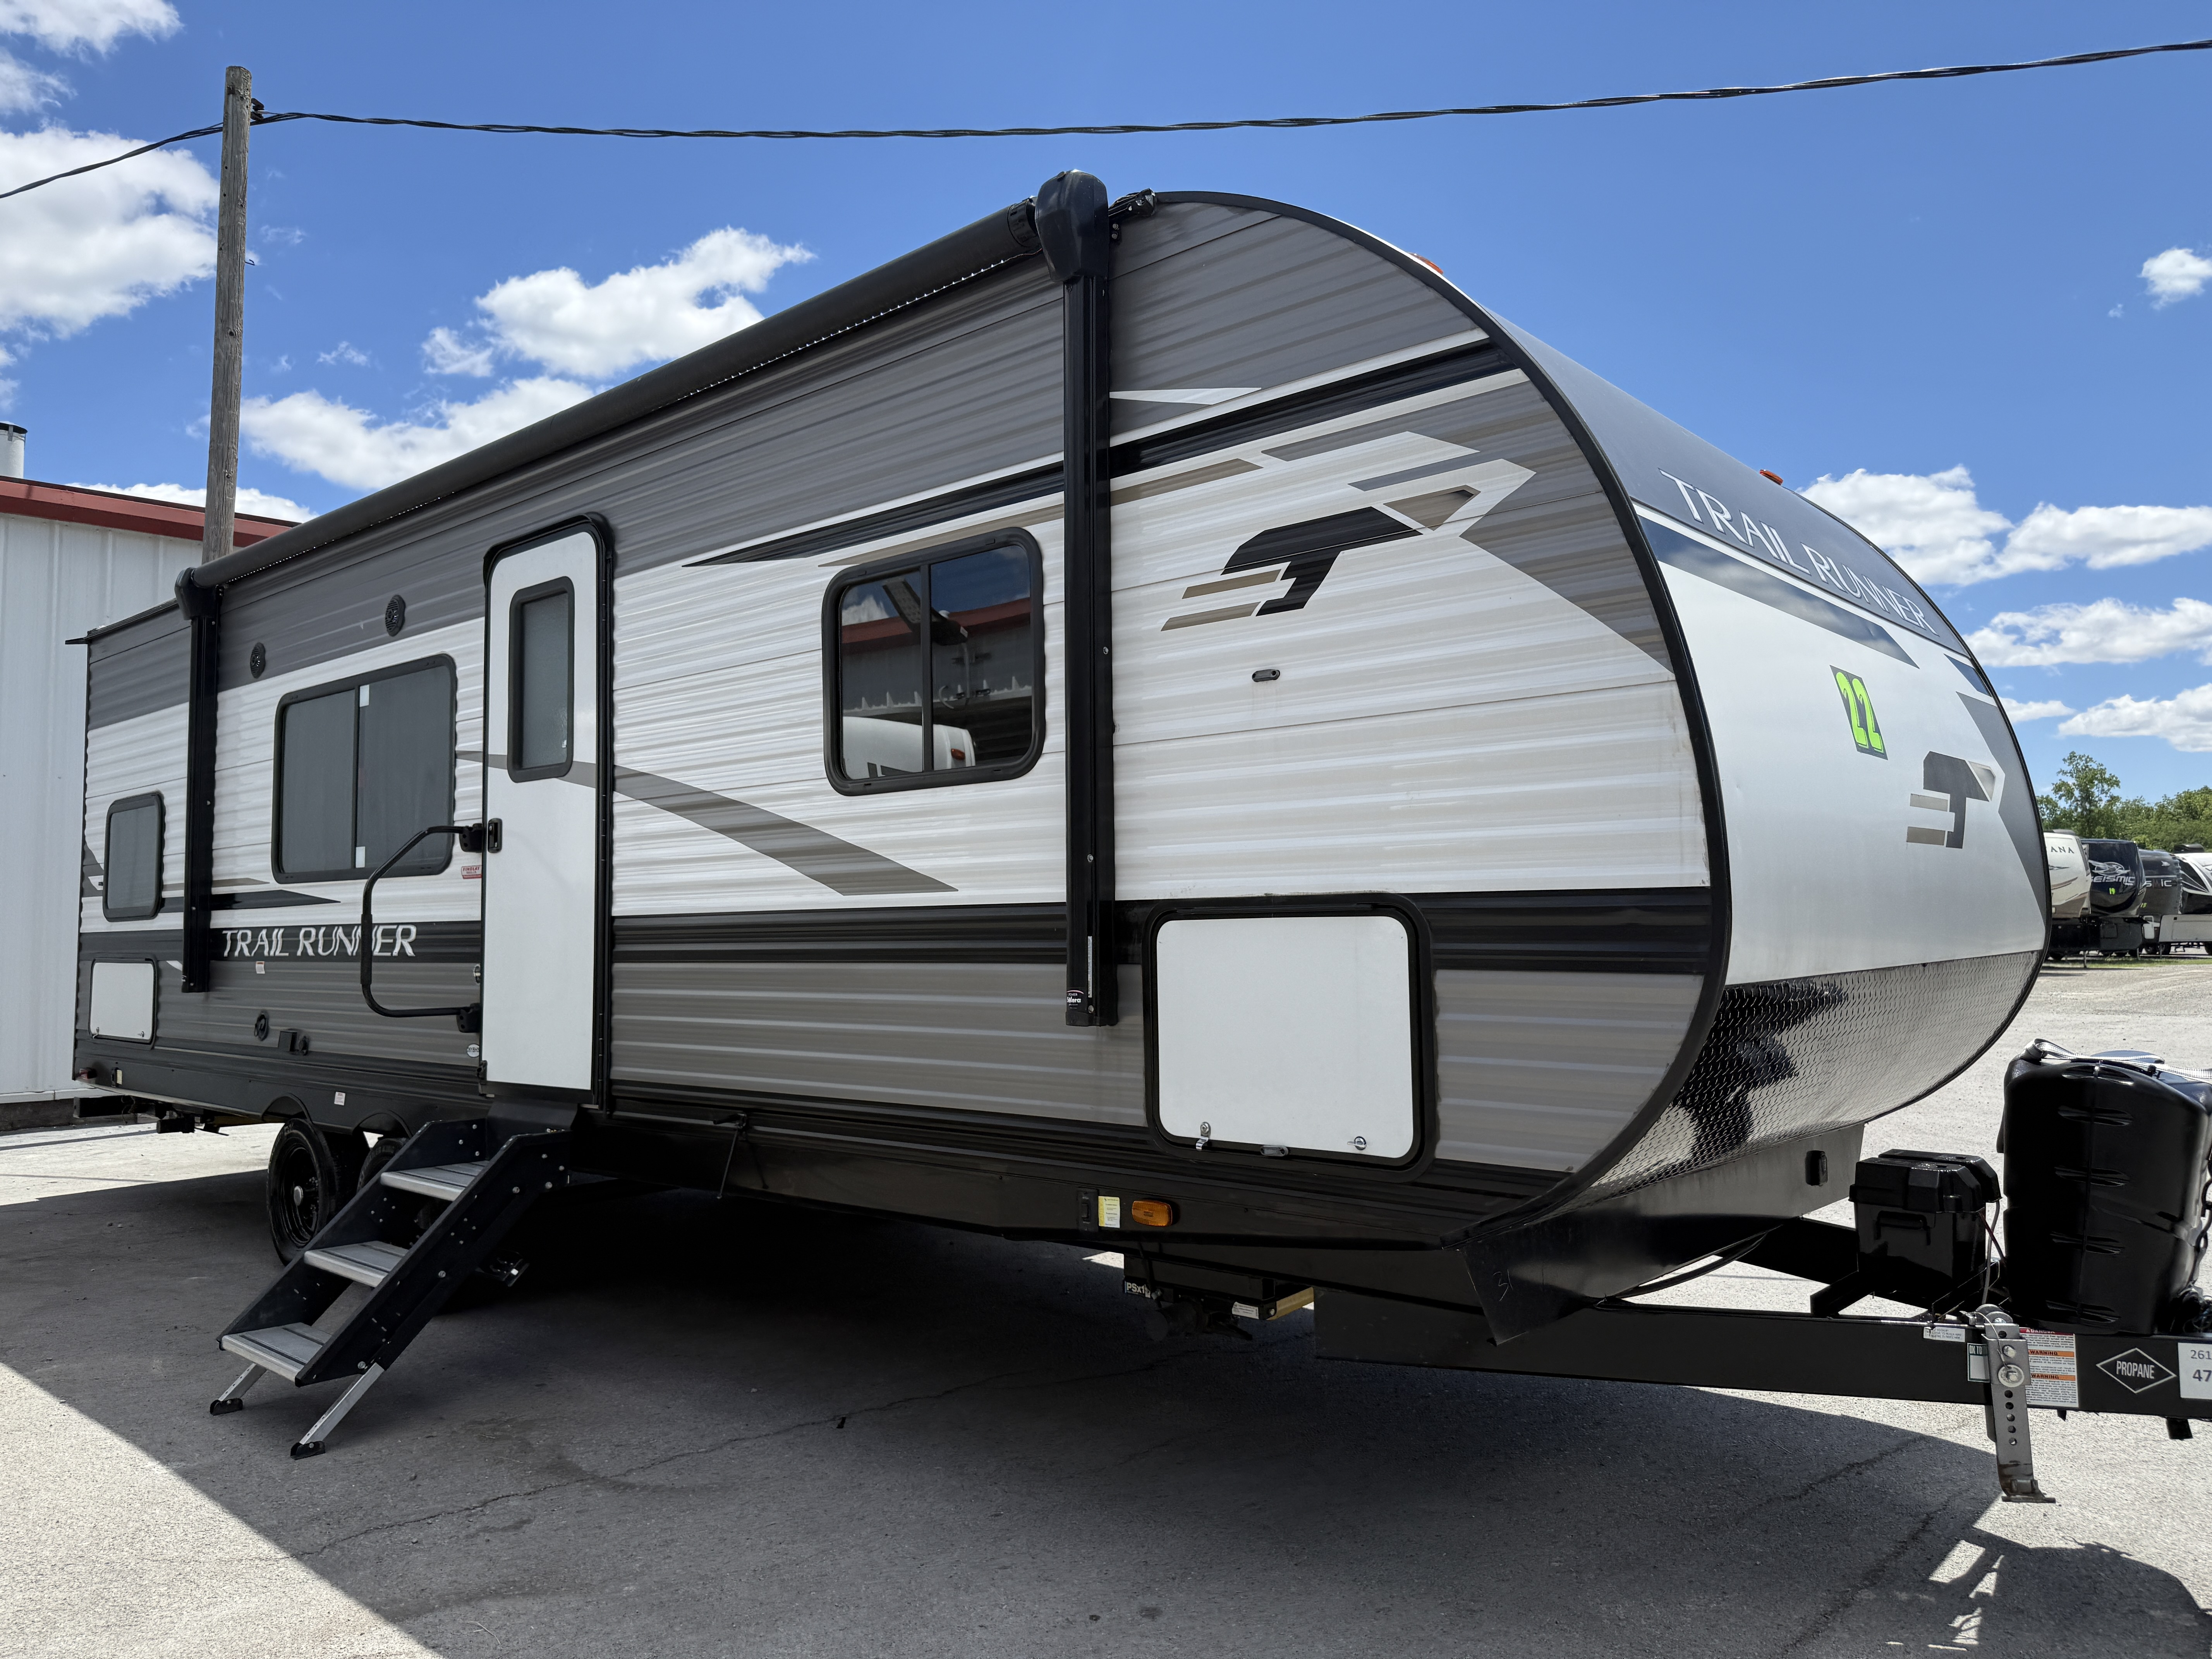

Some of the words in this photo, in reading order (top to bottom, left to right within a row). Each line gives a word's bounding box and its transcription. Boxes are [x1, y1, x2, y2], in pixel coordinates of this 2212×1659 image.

[1658, 468, 1812, 576] TRAIL
[1800, 542, 1940, 637] RUNNER
[1836, 672, 1884, 753] 22
[222, 928, 289, 957] TRAIL
[297, 924, 417, 957] RUNNER
[2116, 1360, 2155, 1379] PROPANE
[2192, 1369, 2212, 1382] 47
